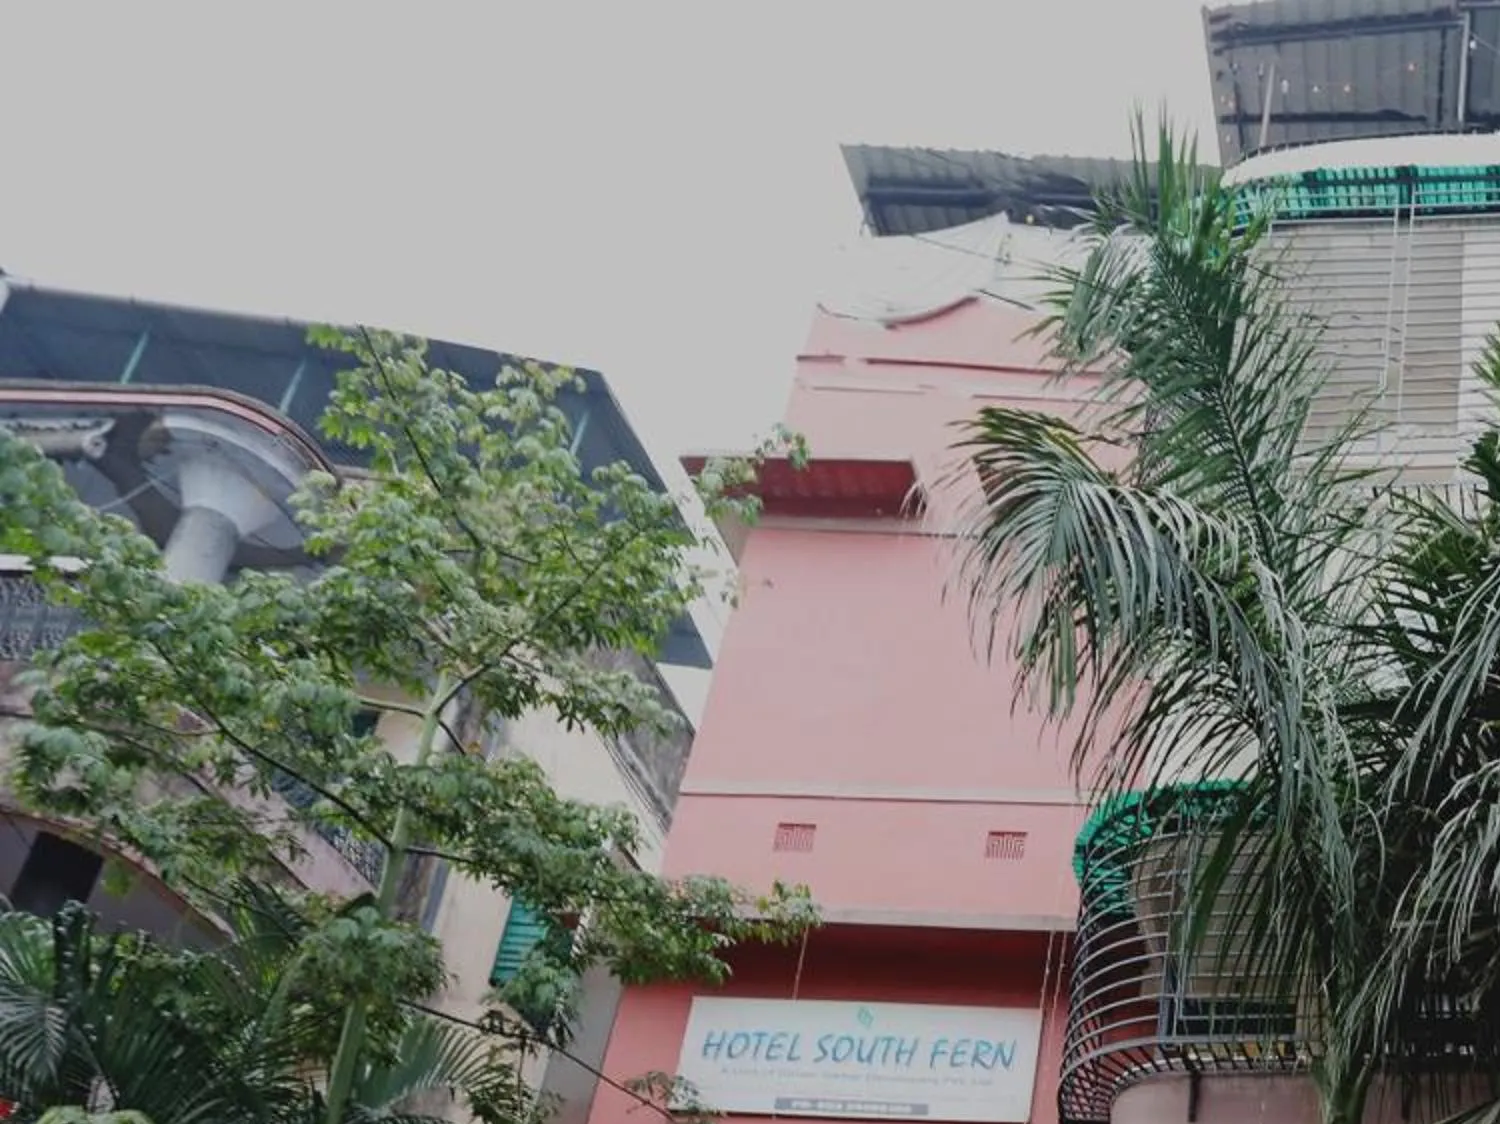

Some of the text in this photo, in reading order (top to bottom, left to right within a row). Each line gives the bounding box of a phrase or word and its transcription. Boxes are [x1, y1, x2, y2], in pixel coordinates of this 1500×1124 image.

[702, 1030, 1017, 1072] HOTEL SOUTH FERN
